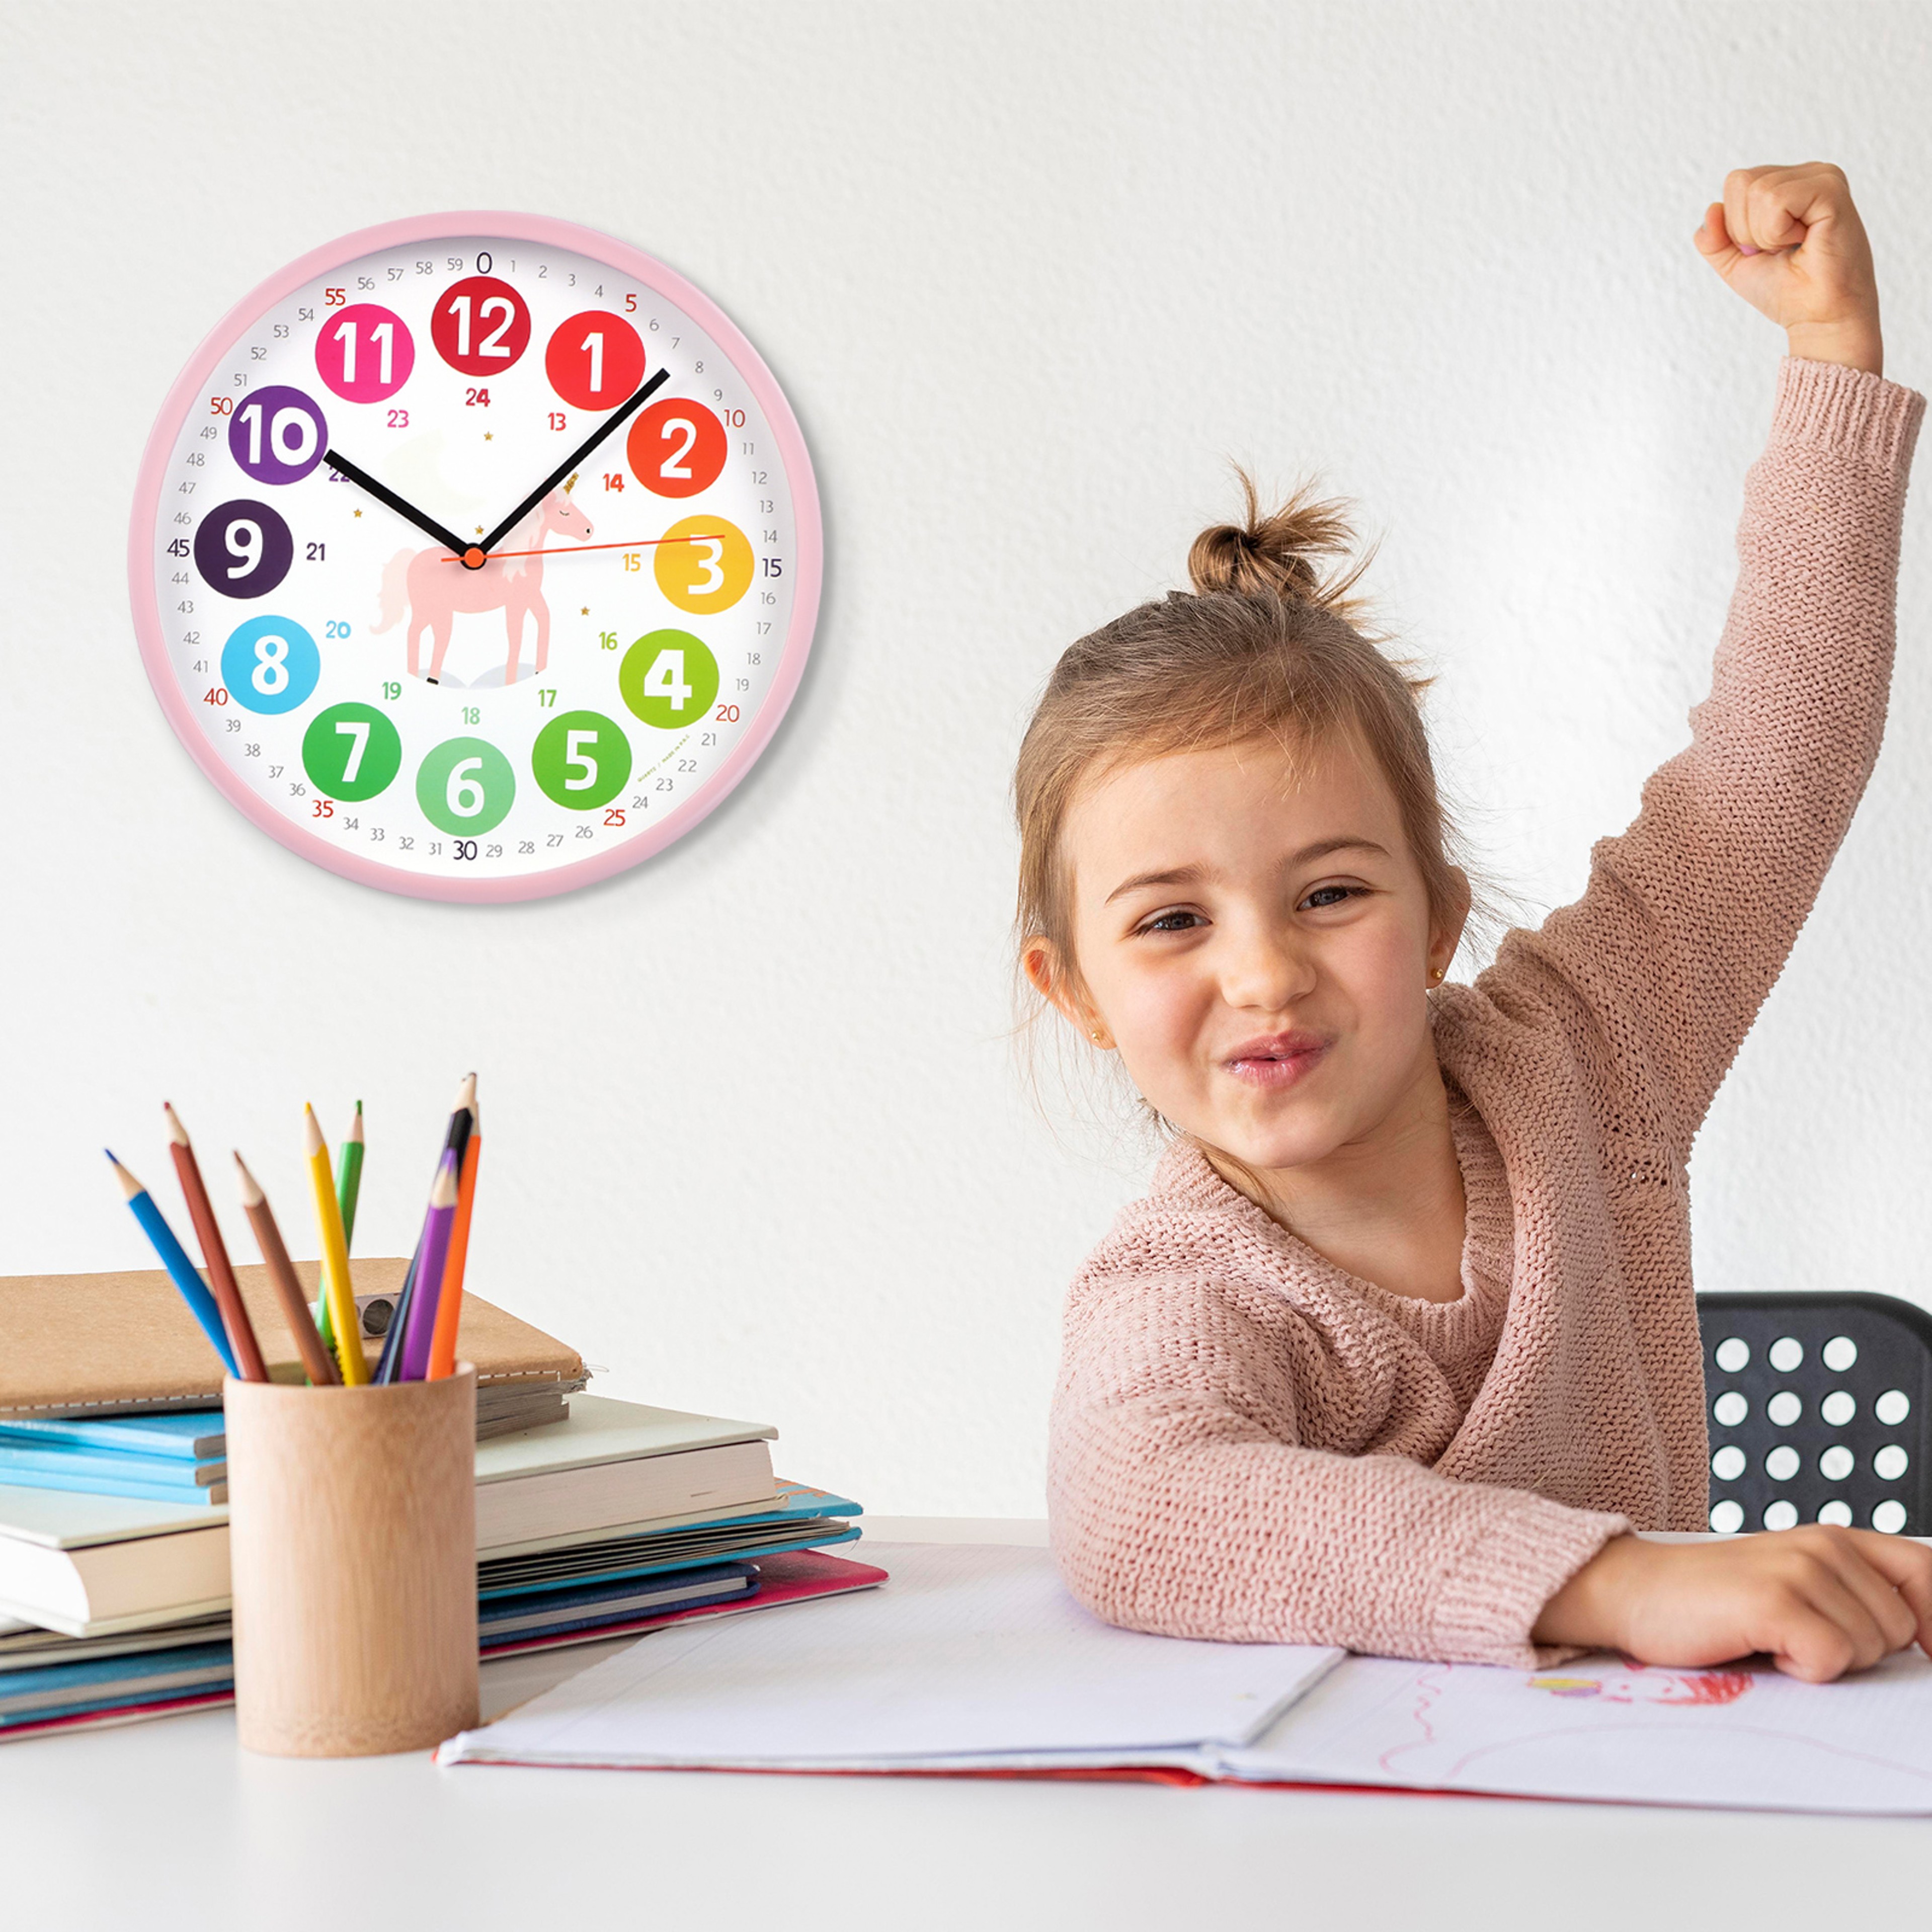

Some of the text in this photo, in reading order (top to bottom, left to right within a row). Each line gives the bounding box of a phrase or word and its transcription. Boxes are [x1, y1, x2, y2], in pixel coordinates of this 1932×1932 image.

[415, 262, 434, 274] 58
[447, 258, 463, 271] 59
[476, 252, 492, 274] 0
[511, 260, 515, 272] 1
[387, 268, 404, 281] 57
[538, 265, 547, 278] 2
[358, 276, 375, 290] 56
[569, 273, 576, 286] 3
[325, 288, 346, 306] 55
[595, 285, 603, 297] 4
[625, 294, 636, 312] 5
[298, 308, 314, 321] 54
[274, 325, 289, 338] 53
[448, 296, 515, 357] 12
[650, 318, 660, 331] 6
[672, 337, 680, 349] 7
[251, 347, 267, 360] 52
[334, 321, 393, 384] 11
[581, 333, 603, 392] 1
[695, 361, 704, 373] 8
[234, 373, 247, 386] 51
[466, 388, 491, 407] 24
[713, 389, 722, 401] 9
[211, 397, 233, 416] 50
[387, 410, 409, 428] 23
[548, 413, 566, 431] 13
[724, 409, 745, 428] 10
[200, 426, 217, 440] 49
[239, 404, 318, 466] 10
[660, 418, 696, 479] 2
[743, 443, 754, 455] 11
[186, 453, 205, 467] 48
[603, 473, 624, 493] 14
[752, 471, 767, 485] 12
[179, 481, 196, 494] 47
[760, 500, 774, 513] 13
[174, 512, 192, 525] 46
[763, 530, 777, 543] 14
[167, 538, 190, 557] 45
[225, 519, 263, 579] 9
[306, 542, 325, 561] 21
[623, 553, 640, 572] 15
[688, 534, 724, 595] 3
[762, 558, 782, 578] 15
[172, 572, 189, 585] 44
[761, 592, 776, 605] 16
[177, 600, 194, 613] 43
[326, 620, 351, 639] 20
[757, 622, 771, 634] 17
[183, 631, 200, 645] 42
[599, 632, 617, 651] 16
[193, 660, 208, 673] 41
[252, 634, 289, 695] 8
[747, 653, 761, 666] 18
[643, 649, 692, 710] 4
[736, 678, 749, 691] 19
[203, 688, 228, 706] 40
[382, 682, 401, 700] 19
[538, 689, 556, 707] 17
[462, 706, 480, 725] 18
[716, 704, 740, 722] 20
[226, 719, 241, 732] 39
[701, 733, 716, 746] 21
[245, 743, 261, 757] 38
[335, 722, 370, 782] 7
[565, 730, 598, 790] 5
[678, 759, 697, 772] 22
[269, 765, 284, 778] 37
[290, 783, 306, 796] 36
[446, 757, 485, 818] 6
[656, 778, 673, 791] 23
[312, 800, 334, 818] 35
[632, 796, 648, 809] 24
[344, 817, 359, 830] 34
[604, 809, 625, 827] 25
[371, 828, 384, 841] 33
[575, 826, 593, 839] 26
[399, 836, 414, 850] 32
[518, 841, 535, 854] 28
[546, 834, 564, 847] 27
[429, 842, 441, 855] 31
[454, 840, 477, 860] 30
[486, 844, 503, 857] 29
